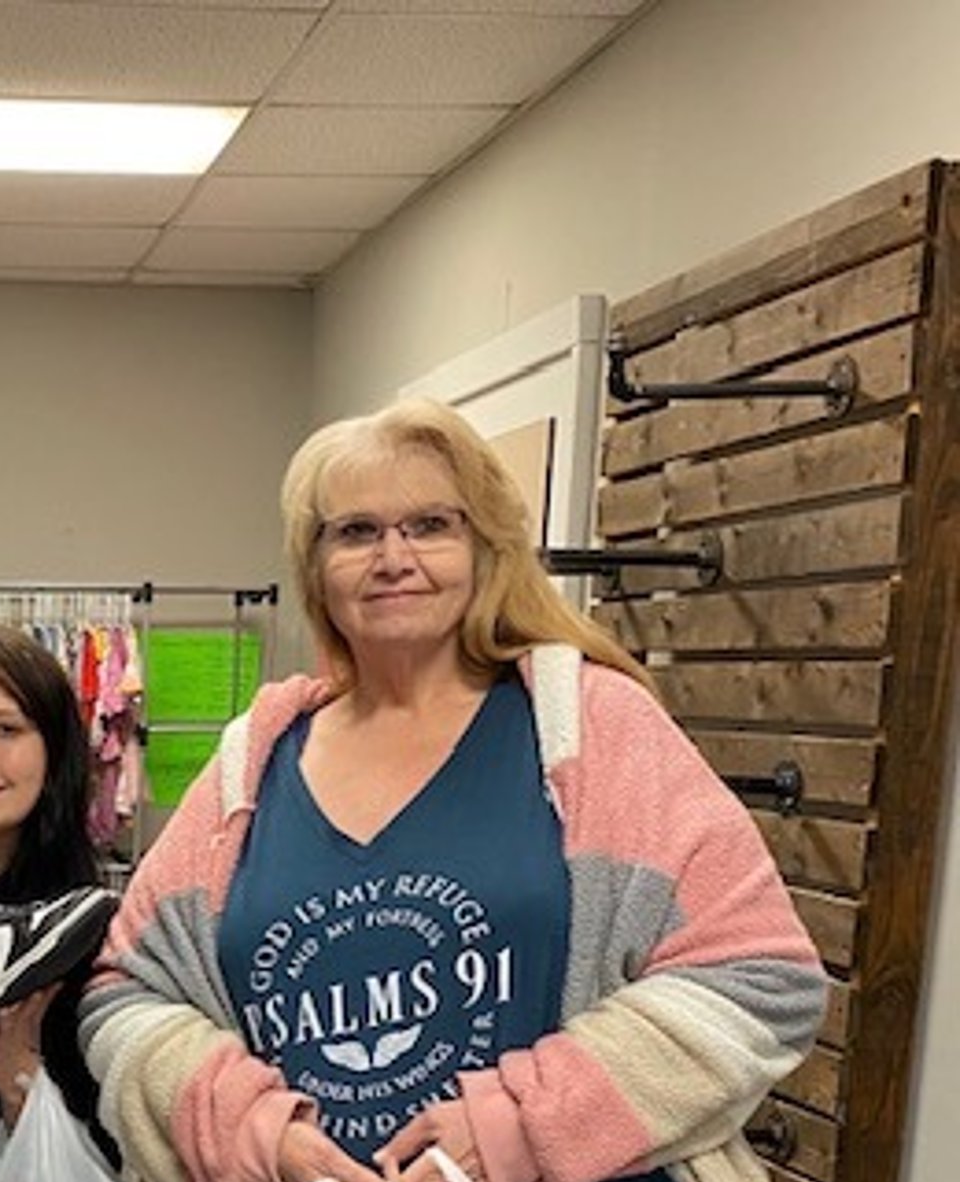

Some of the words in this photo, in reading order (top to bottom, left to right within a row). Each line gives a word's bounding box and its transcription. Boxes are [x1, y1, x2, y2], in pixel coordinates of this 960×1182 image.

[250, 921, 292, 992] GOD
[295, 896, 325, 924] IS
[335, 878, 386, 909] MY
[393, 874, 491, 944] REFUGE
[287, 937, 320, 980] AND
[325, 917, 355, 939] MY
[365, 908, 445, 948] FORTRESS
[243, 959, 438, 1051] PSALMS
[455, 947, 512, 1009] 91
[298, 1070, 355, 1101] UNDER
[358, 1082, 393, 1101] HIS
[395, 1041, 456, 1091] WINGS
